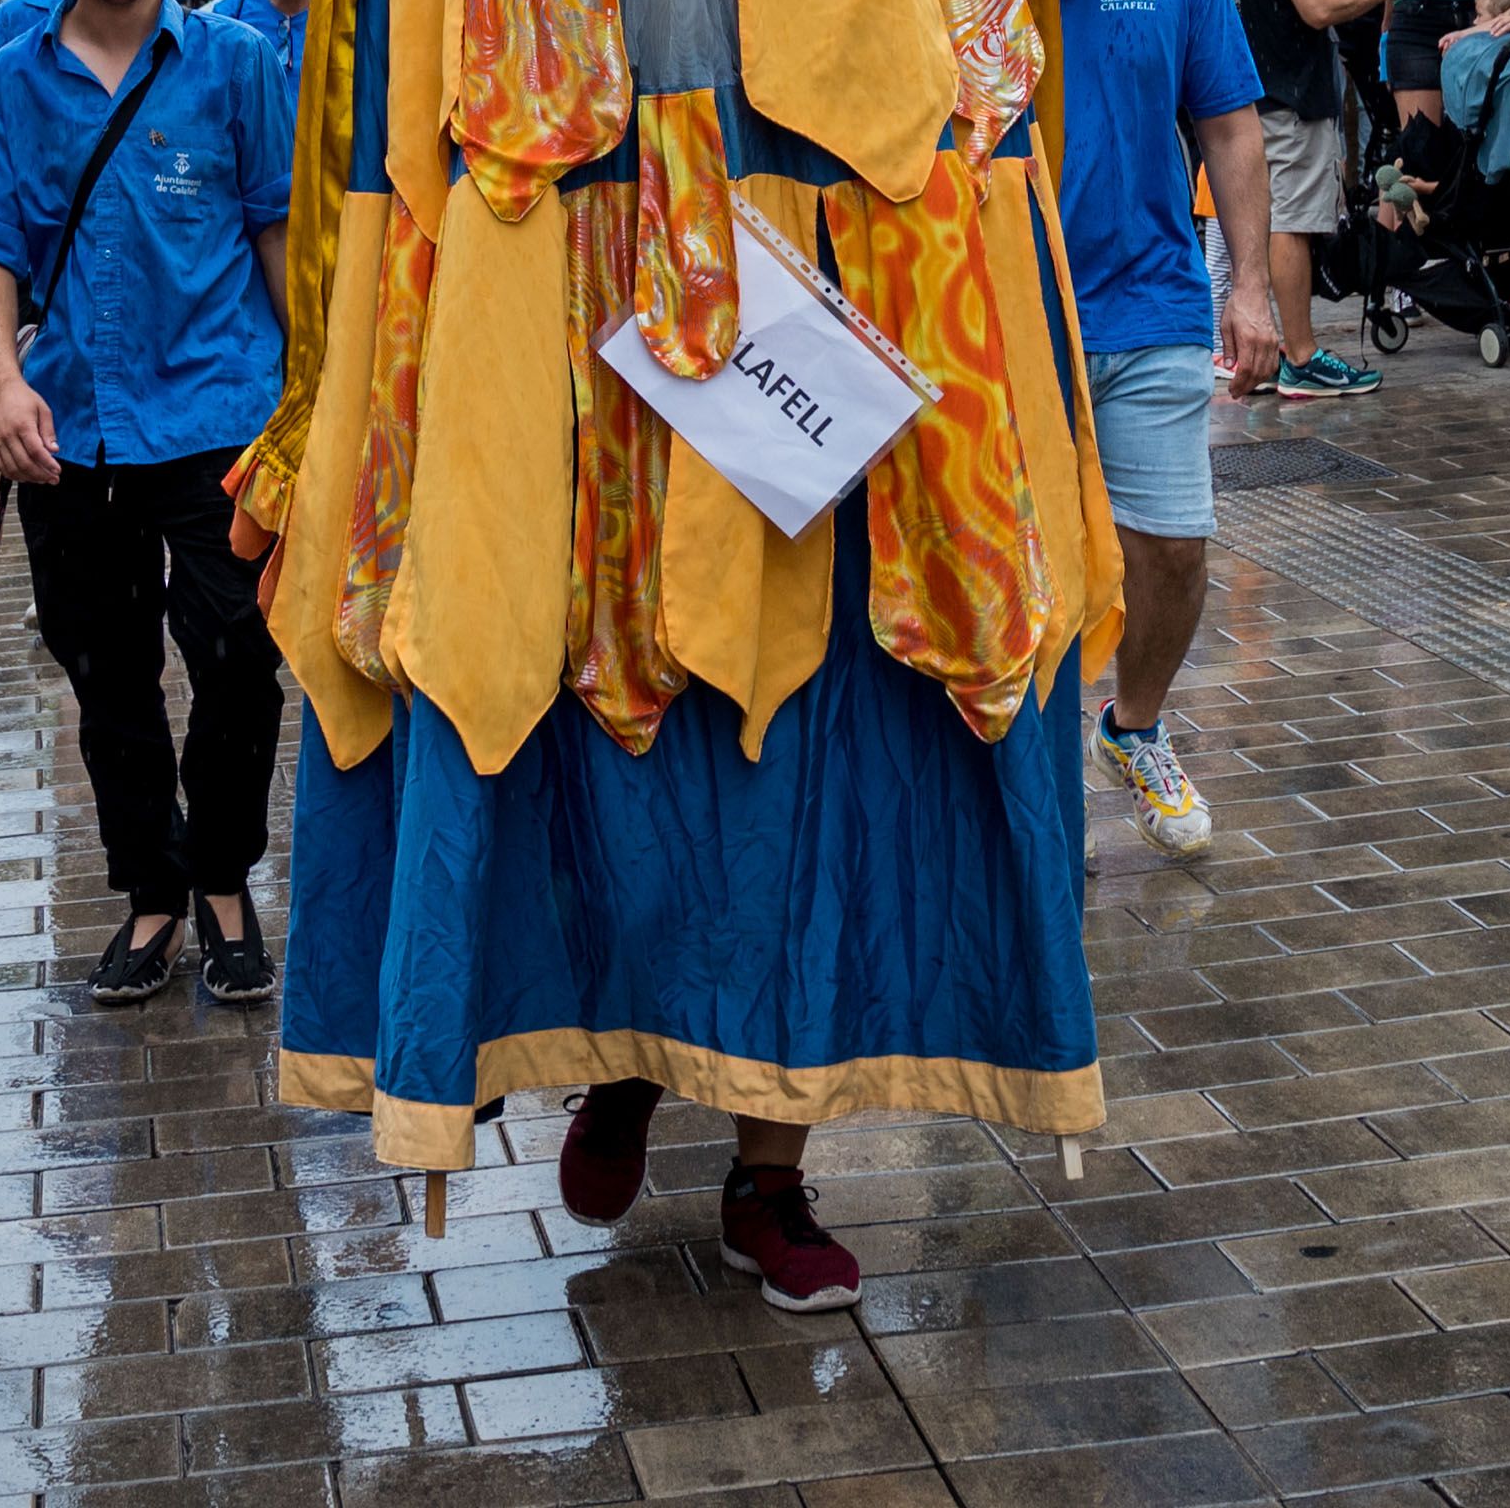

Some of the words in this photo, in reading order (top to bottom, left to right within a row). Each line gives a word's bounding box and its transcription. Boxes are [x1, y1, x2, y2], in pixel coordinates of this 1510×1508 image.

[1100, 1, 1156, 11] CALAFELL
[154, 174, 202, 187] Ajuntament
[156, 182, 168, 193] de
[170, 184, 198, 196] Calafell
[732, 330, 834, 448] LAFELL
